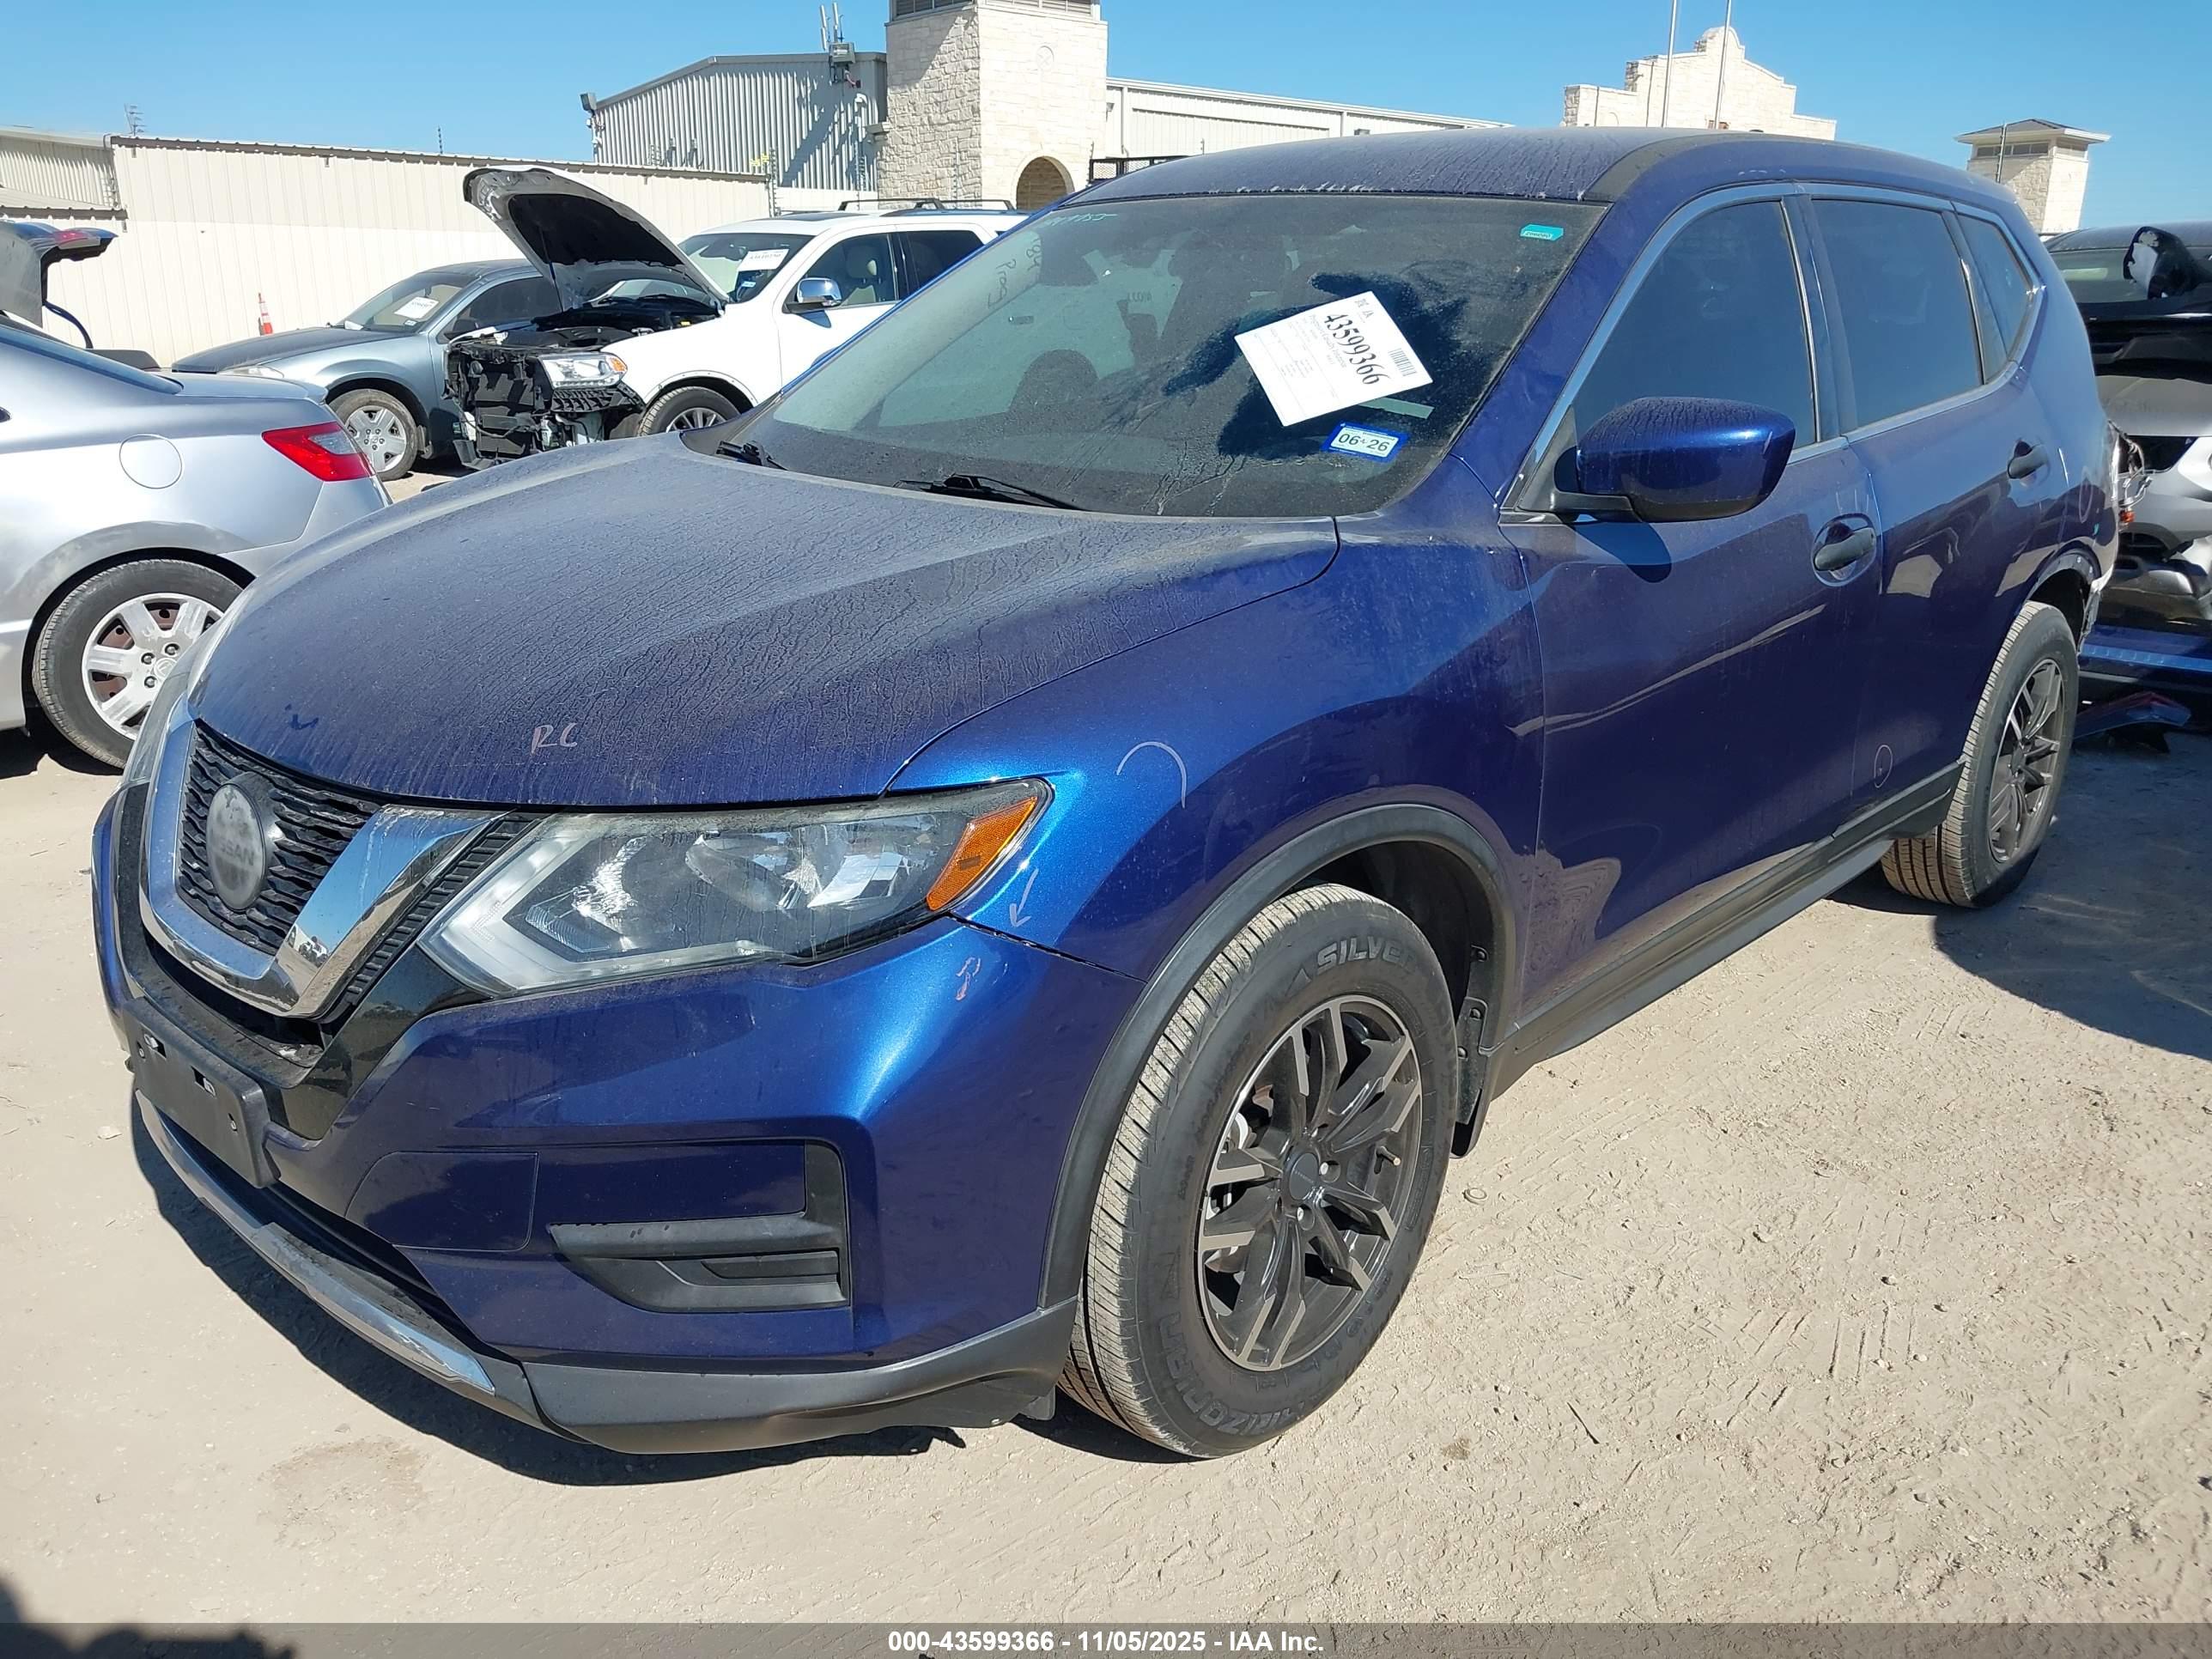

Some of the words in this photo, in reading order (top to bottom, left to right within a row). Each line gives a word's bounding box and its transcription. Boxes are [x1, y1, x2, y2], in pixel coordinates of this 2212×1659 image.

[1323, 313, 1391, 385] 43599366
[1338, 433, 1361, 446] 06
[1365, 439, 1390, 452] 26
